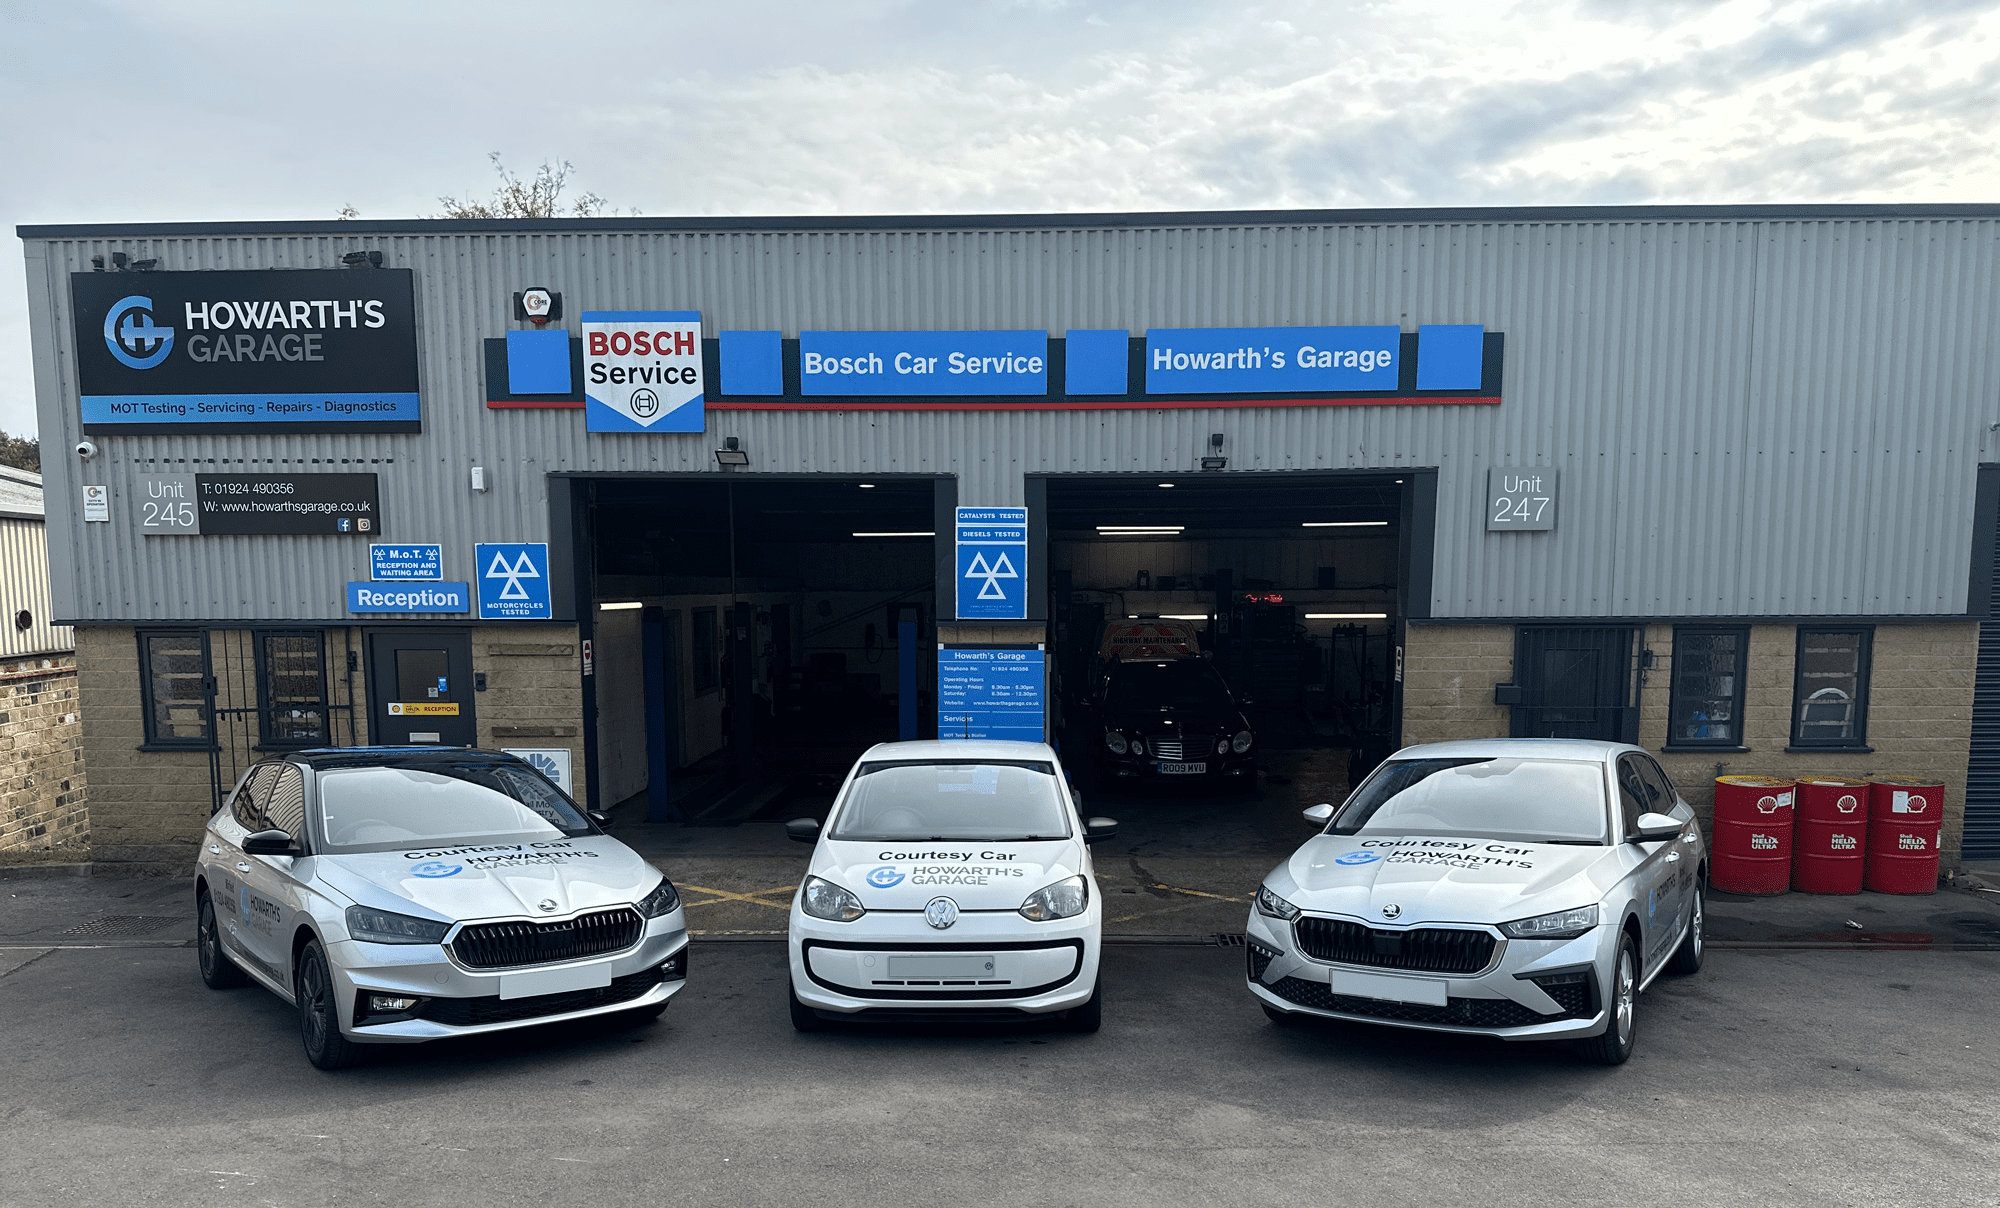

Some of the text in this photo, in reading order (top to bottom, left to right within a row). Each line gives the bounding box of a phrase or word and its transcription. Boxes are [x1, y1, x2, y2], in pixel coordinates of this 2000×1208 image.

[185, 299, 386, 330] HOWARTH'S
[187, 333, 325, 363] GARAGE
[588, 331, 696, 356] BOSCH
[804, 352, 1043, 375] Bosch Car Service
[1153, 345, 1393, 373] Howarth's Garage
[589, 361, 697, 385] Service
[110, 402, 139, 414] MOT
[141, 402, 187, 416] Testing
[197, 400, 256, 416] Servicing
[266, 401, 313, 414] Repairs
[324, 399, 397, 415] Diagnostics
[148, 481, 184, 498] Unit
[202, 483, 294, 495] T: 01924 490356
[1504, 475, 1542, 493] Unit
[143, 502, 194, 527] 245
[203, 500, 371, 515] W: www.howarthsgarage.co.uk
[1494, 497, 1550, 522] 247
[389, 550, 422, 560] M.o.T.
[380, 569, 434, 577] WAITING AREA
[358, 588, 459, 610] Reception
[487, 602, 544, 610] MOTORCYCLES
[501, 608, 530, 616] TESTED
[1113, 636, 1188, 645] HIGHWAY MAINTENANCE
[954, 652, 1026, 661] Howarth's Garage
[403, 844, 523, 860] Courtesy
[878, 850, 1016, 861] Courtesy Car
[1361, 840, 1534, 856] Courtesy Car
[465, 851, 599, 865] HOWARTH'S
[473, 857, 568, 870] GARAGE
[1386, 857, 1483, 870] GARAGE
[1391, 850, 1533, 869] HOWARTH'S
[913, 866, 1024, 877] HOWARTH'S
[911, 876, 988, 885] GARAGE
